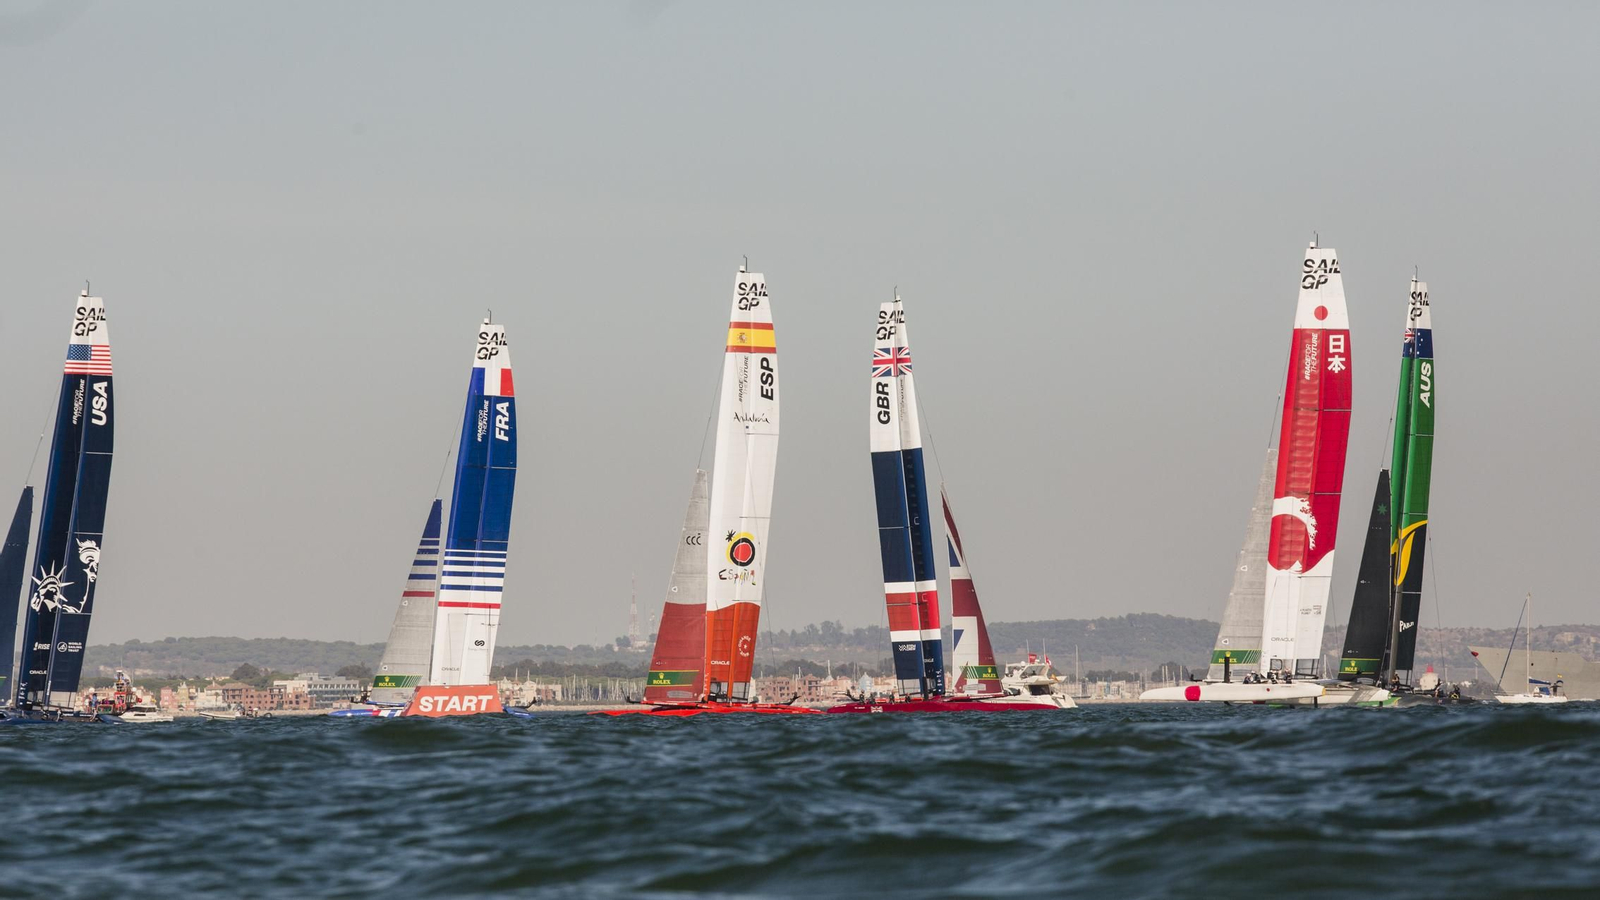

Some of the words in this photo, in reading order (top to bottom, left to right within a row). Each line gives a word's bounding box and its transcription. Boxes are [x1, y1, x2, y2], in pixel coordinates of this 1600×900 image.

[1303, 259, 1341, 274] SAIL
[738, 282, 769, 296] SAIL
[1302, 274, 1329, 290] GP
[738, 297, 760, 311] GP
[75, 307, 107, 321] SAIL
[878, 310, 906, 325] SAIL
[74, 322, 97, 337] GP
[876, 326, 897, 341] GP
[478, 331, 508, 346] SAIL
[476, 347, 499, 361] GP
[1328, 334, 1346, 374] 日本
[760, 356, 774, 401] ESP
[1420, 361, 1432, 409] AUS
[91, 381, 108, 426] USA
[876, 381, 891, 425] GBR
[495, 401, 510, 442] FRA
[419, 695, 493, 713] START
